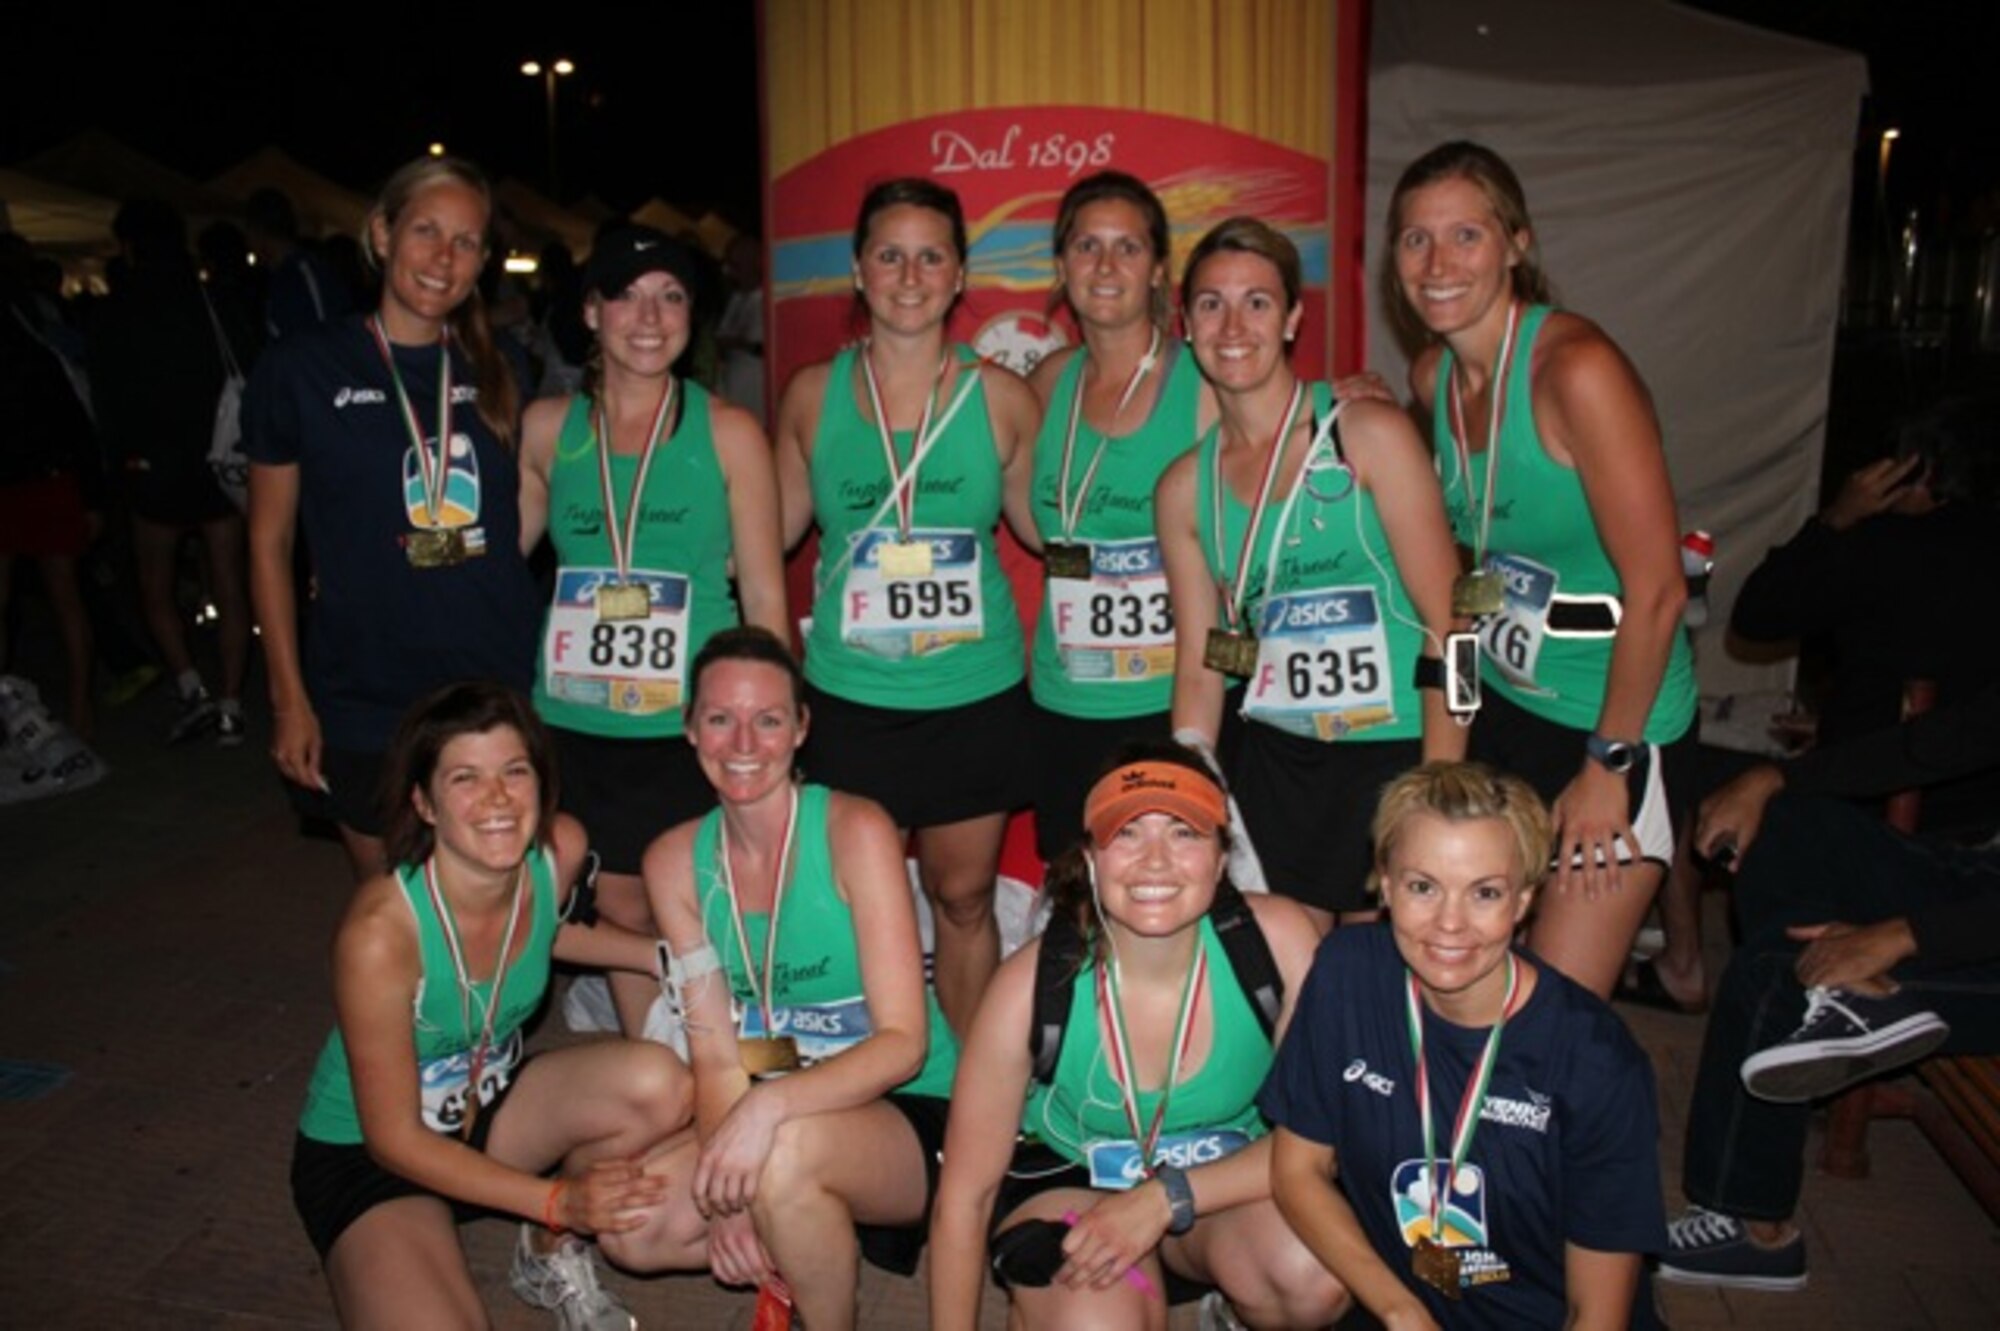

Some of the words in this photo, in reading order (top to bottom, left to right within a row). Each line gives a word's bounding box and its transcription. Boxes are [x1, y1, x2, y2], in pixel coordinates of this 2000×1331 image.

[931, 124, 1021, 174] Dal
[1027, 132, 1115, 177] 1898
[851, 591, 869, 621] F
[887, 580, 973, 620] 695
[1057, 602, 1074, 636] F
[1090, 593, 1176, 638] 833
[554, 630, 574, 663] F
[589, 624, 678, 671] 838
[1255, 663, 1275, 698] F
[1287, 646, 1380, 700] 635
